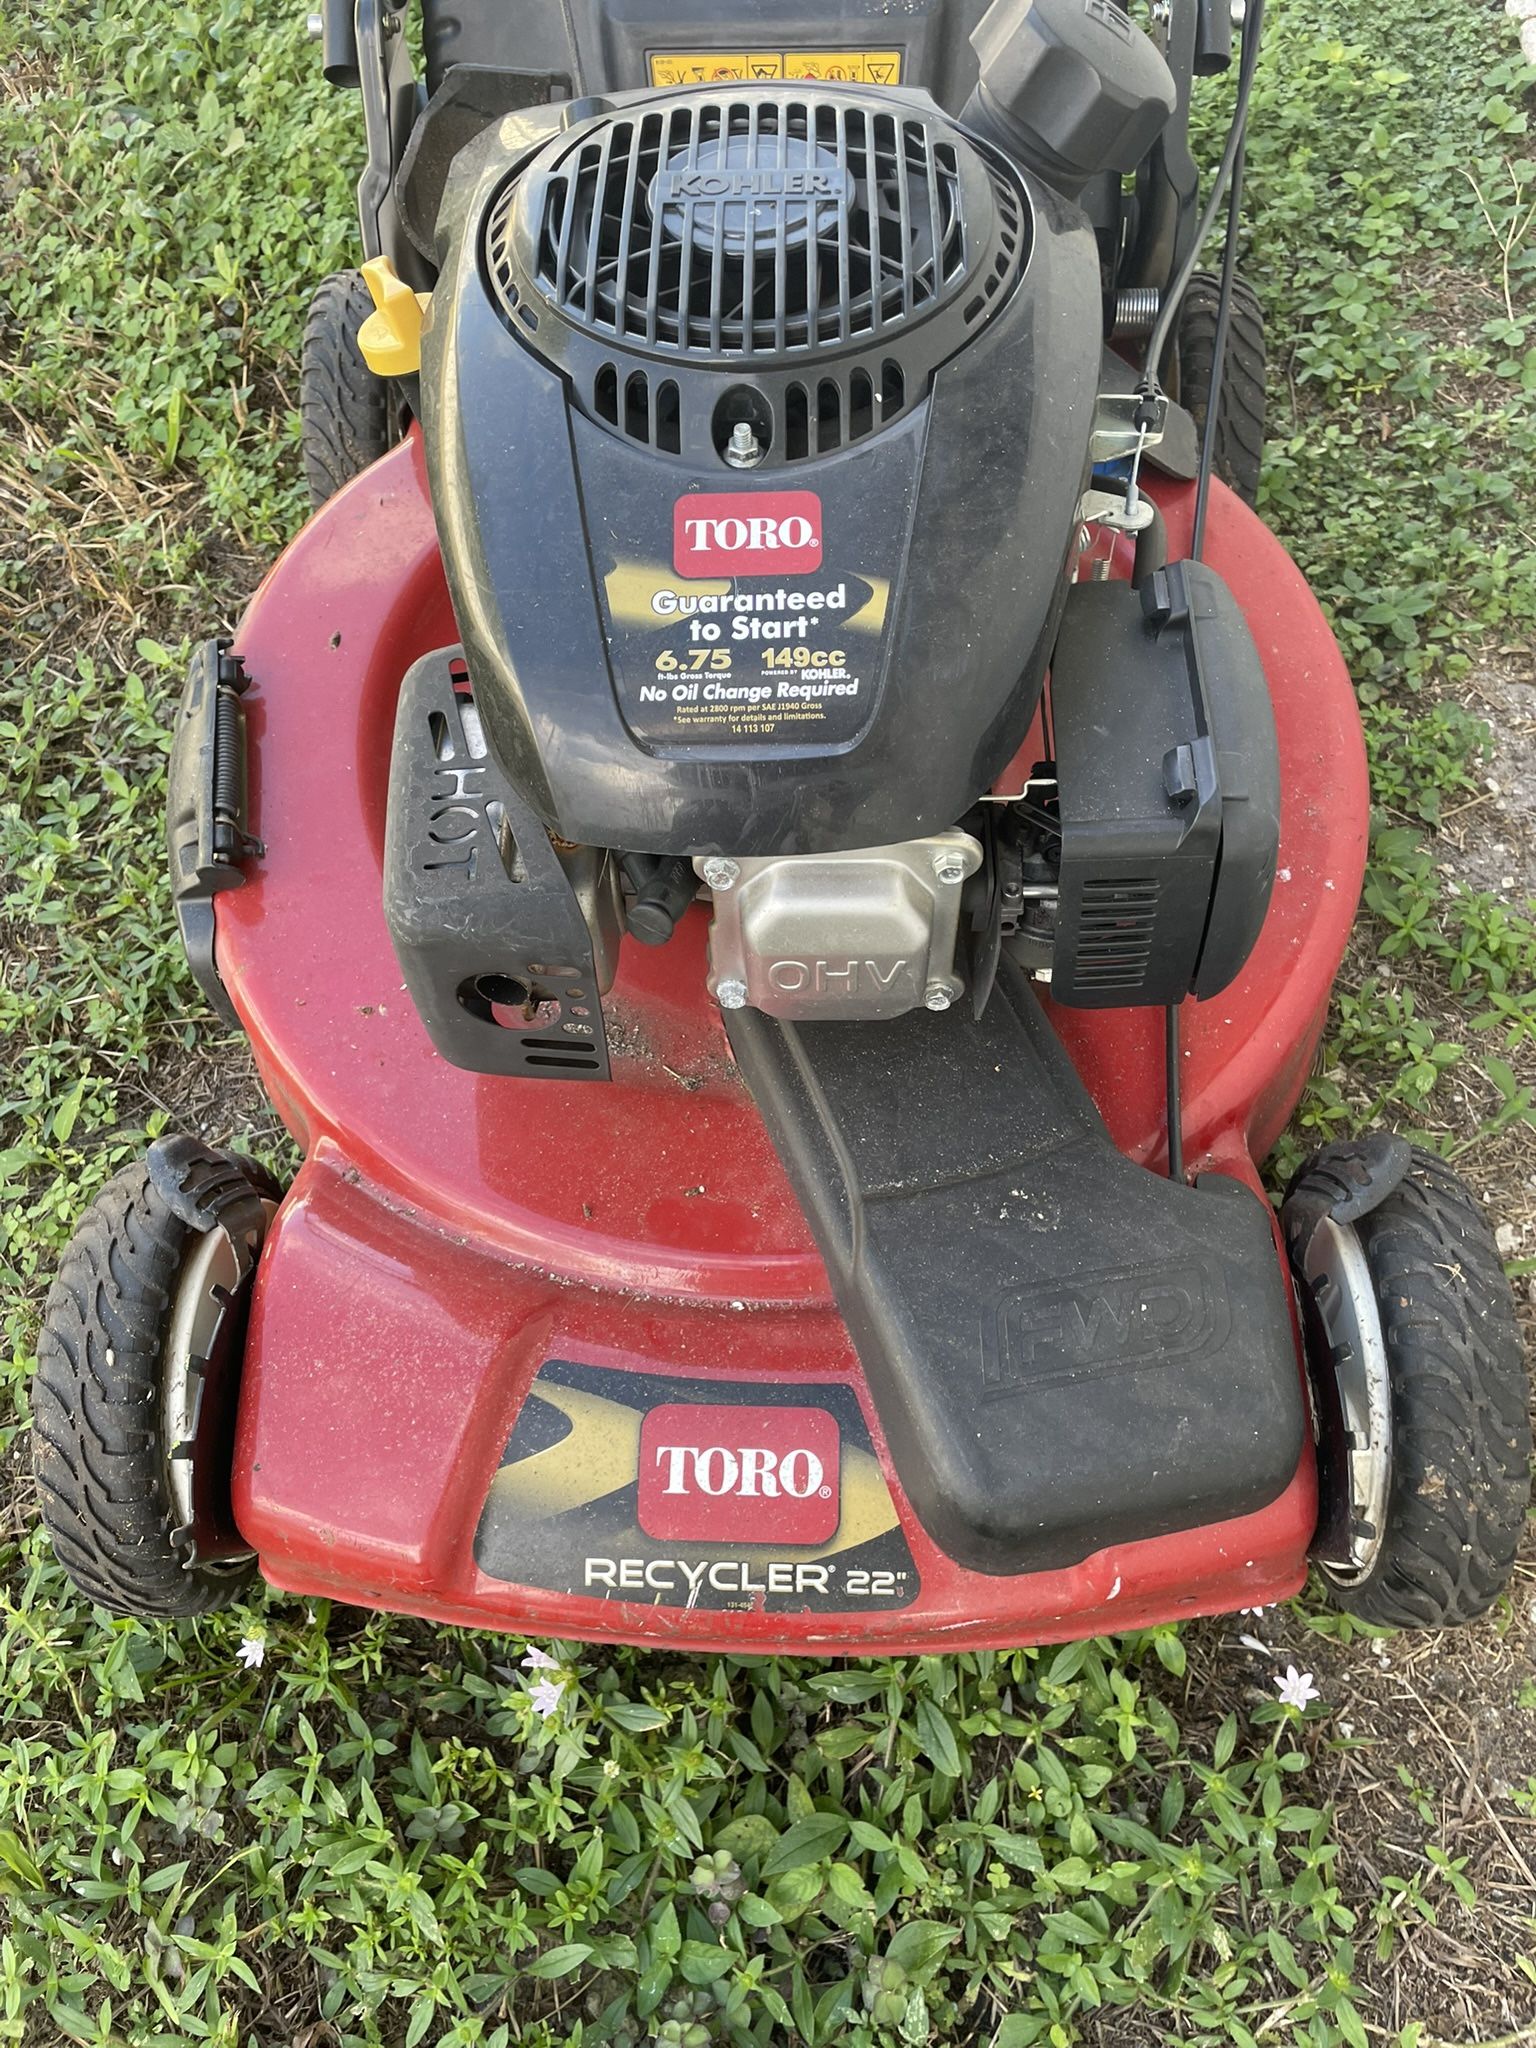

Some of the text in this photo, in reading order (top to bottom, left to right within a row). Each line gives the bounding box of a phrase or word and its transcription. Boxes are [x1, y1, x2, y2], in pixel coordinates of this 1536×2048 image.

[671, 174, 831, 197] KOHLER
[685, 516, 812, 550] TORO
[651, 584, 846, 615] Guaranteed
[689, 619, 721, 641] to
[655, 648, 732, 671] 6.75
[761, 647, 846, 668] 149cc
[680, 672, 703, 680] Gross
[704, 671, 732, 680] Torque
[639, 678, 859, 703] No Oil Change Required
[676, 702, 823, 714] Rated at 2800 rpm per SAE J1940 Gross
[693, 714, 727, 724] warranty
[728, 714, 740, 722] for
[741, 713, 767, 722] details
[768, 713, 783, 721] and
[784, 711, 827, 721] limitations.
[731, 723, 776, 733] 14 113 107
[423, 766, 487, 882] HOT
[768, 960, 907, 993] OHV
[655, 1446, 825, 1499] TORO
[584, 1557, 830, 1594] RECYCLER
